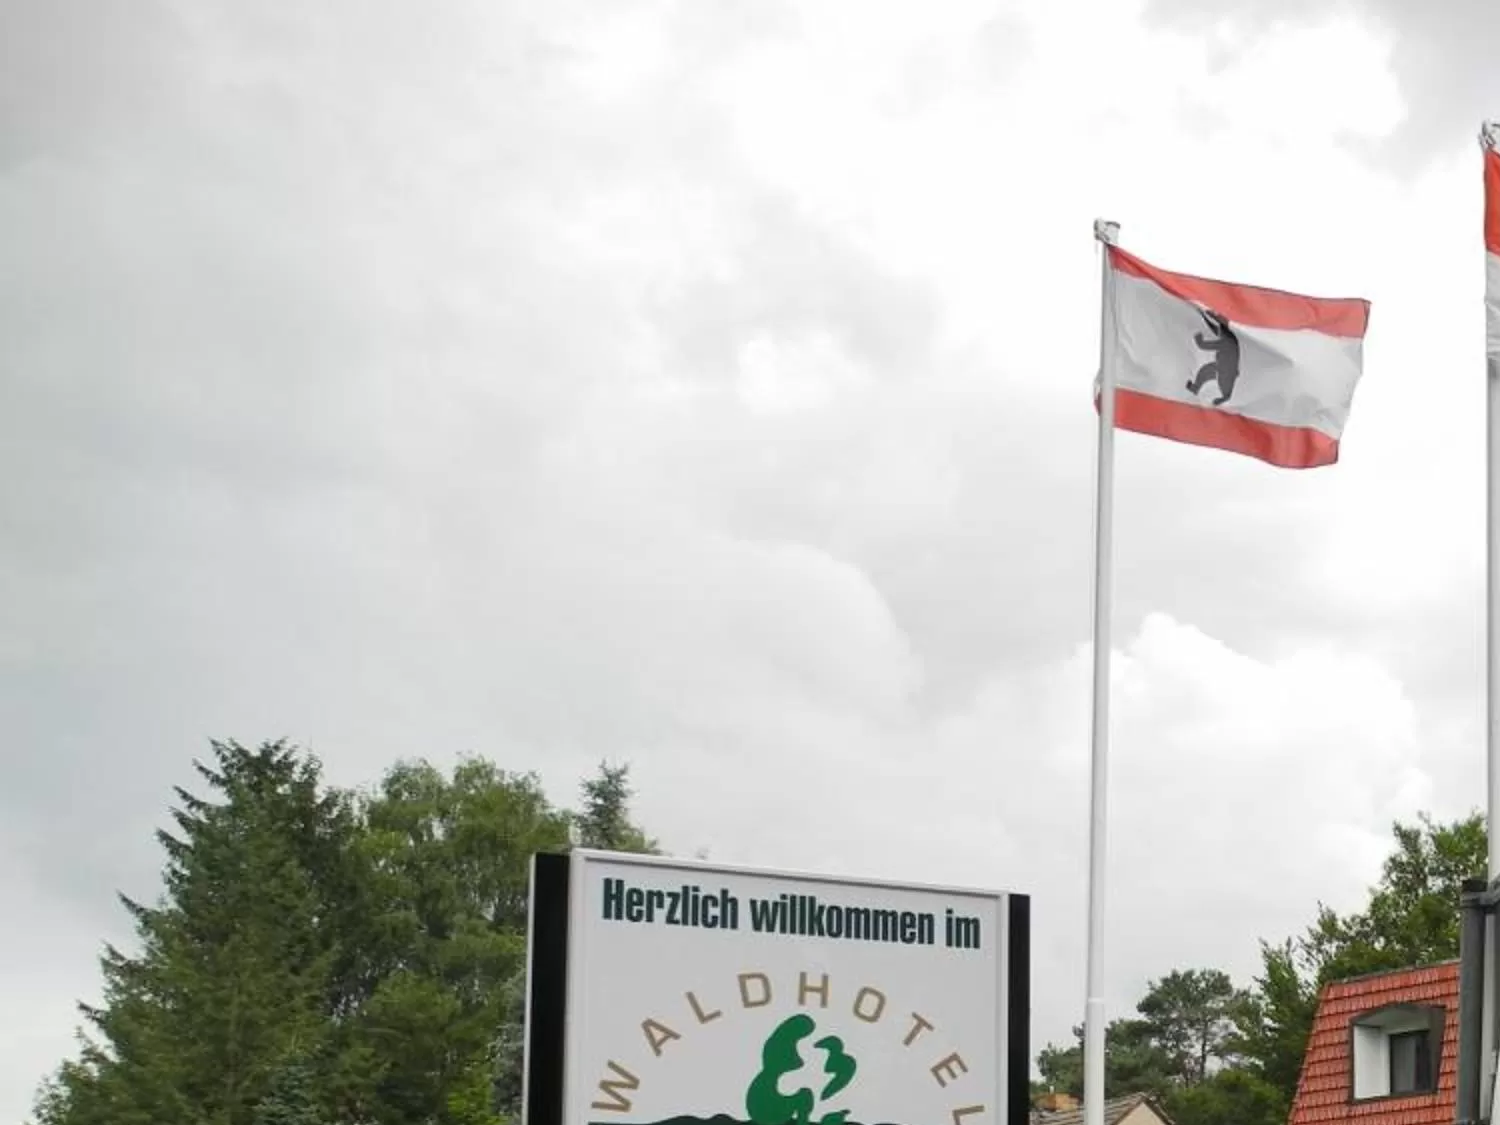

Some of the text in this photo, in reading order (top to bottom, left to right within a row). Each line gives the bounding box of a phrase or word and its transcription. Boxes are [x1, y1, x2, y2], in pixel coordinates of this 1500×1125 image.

[602, 878, 981, 949] Herzlich willkommen im
